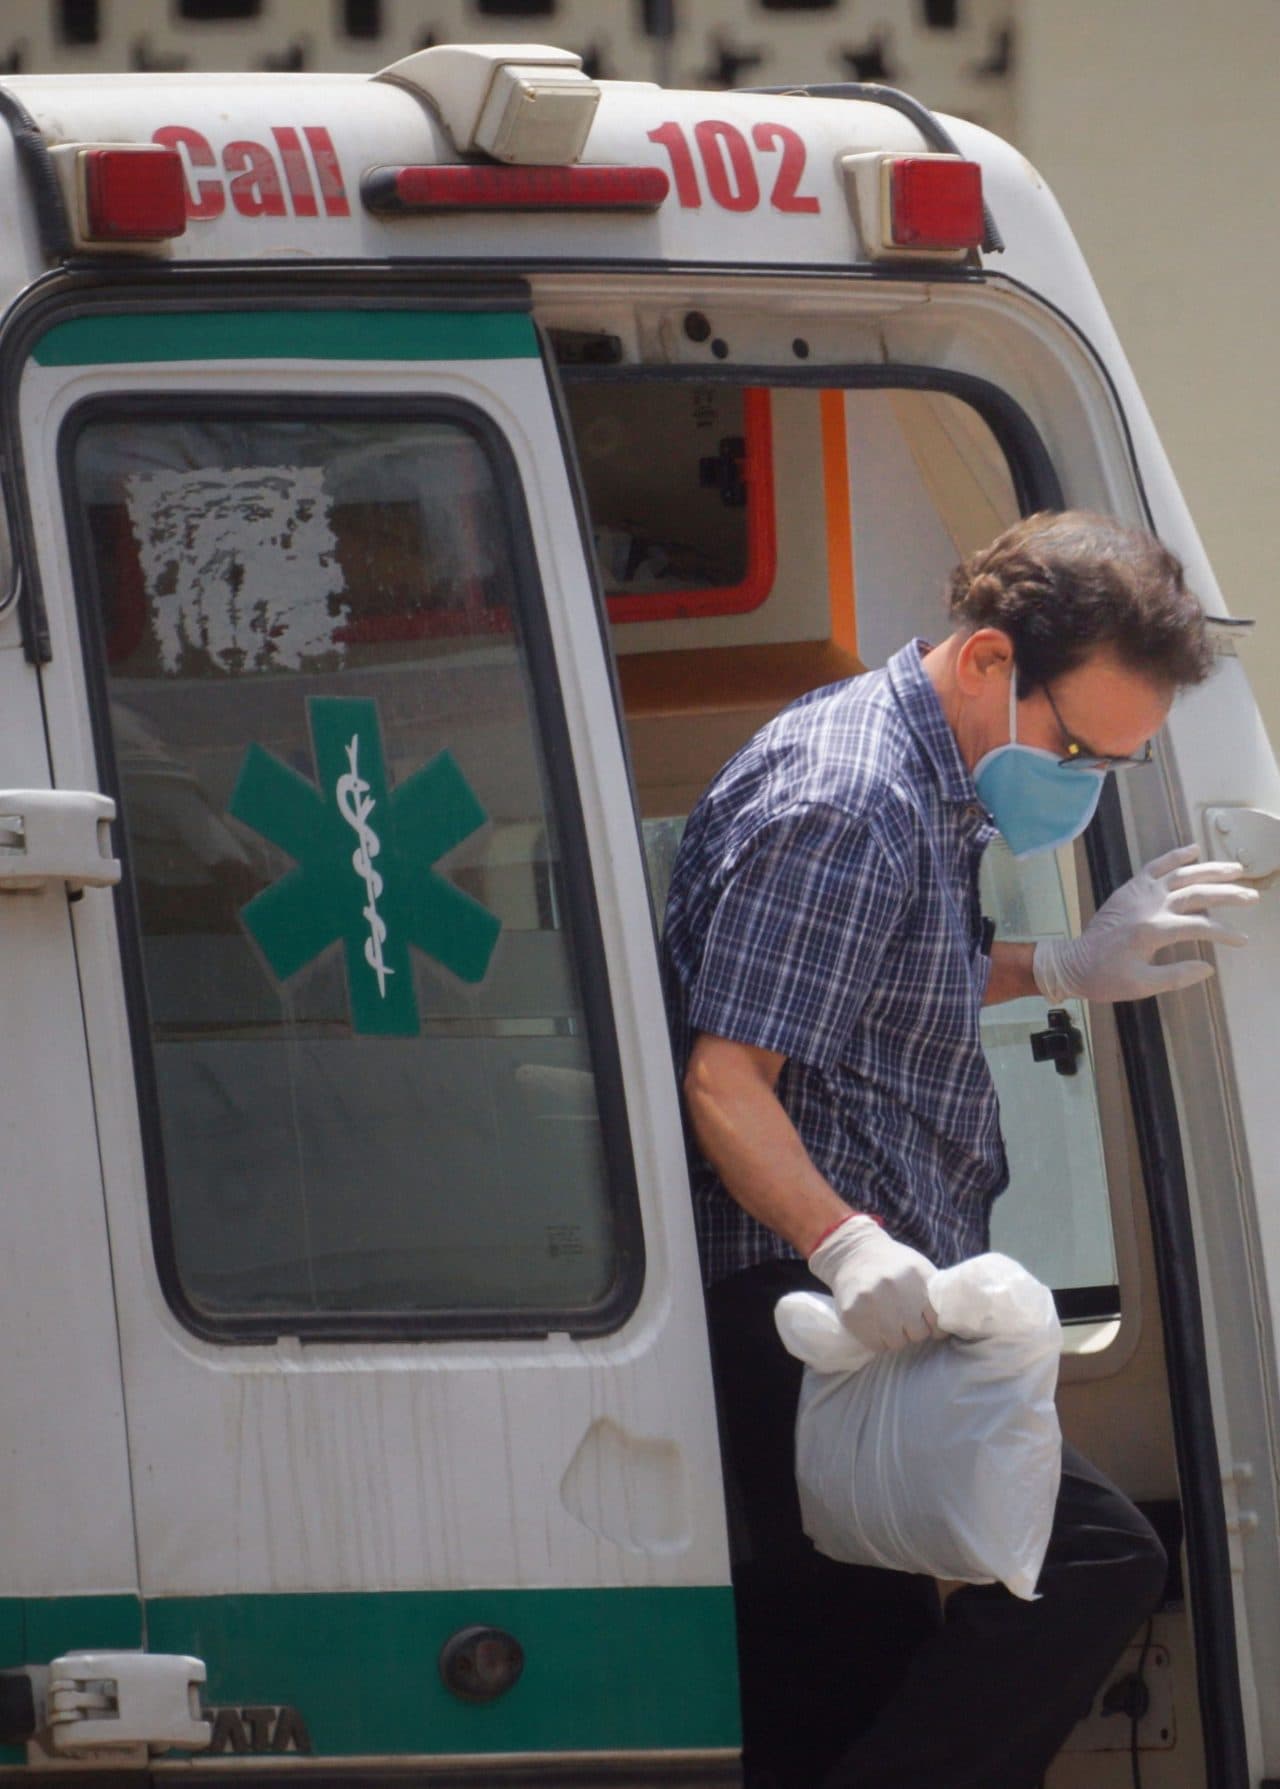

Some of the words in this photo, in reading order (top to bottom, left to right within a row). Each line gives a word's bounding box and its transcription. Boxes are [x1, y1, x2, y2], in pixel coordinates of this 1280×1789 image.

[152, 125, 351, 220] Call
[646, 120, 821, 214] 102
[202, 1706, 313, 1752] ATA
